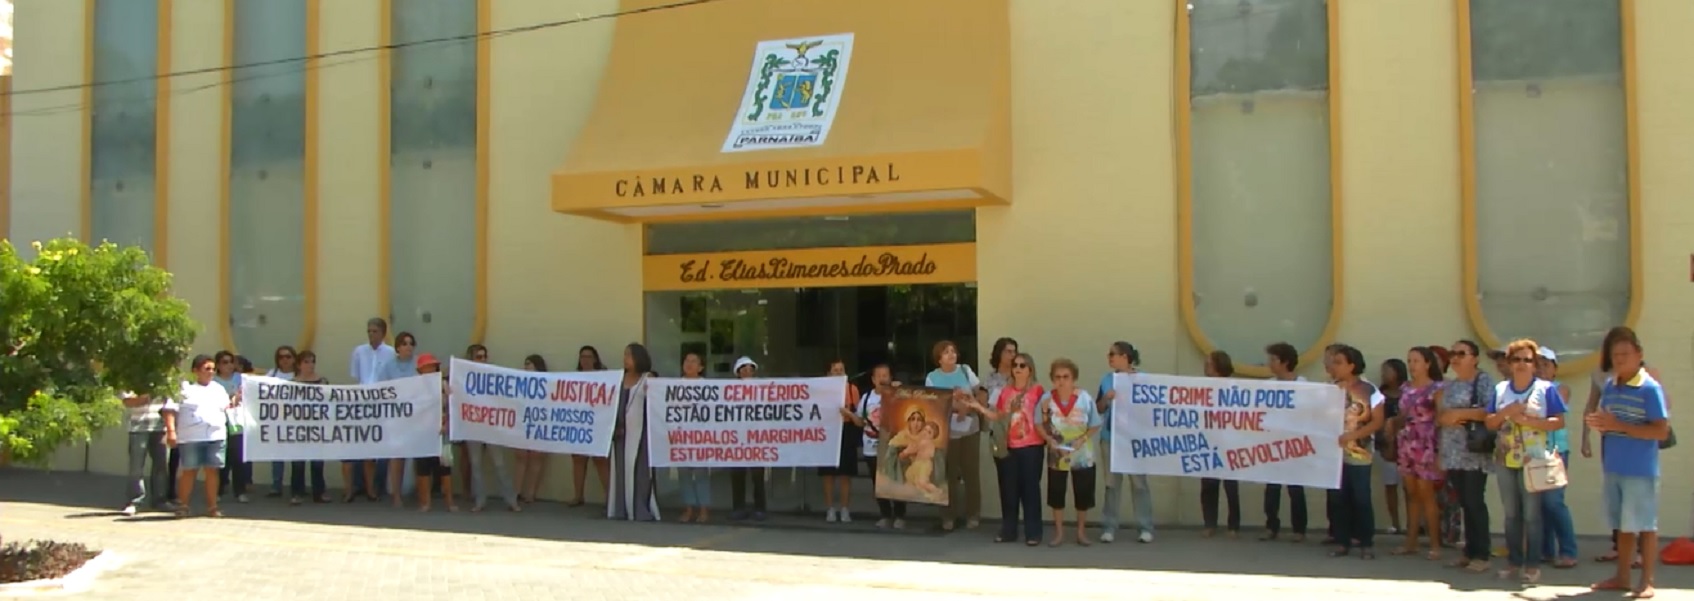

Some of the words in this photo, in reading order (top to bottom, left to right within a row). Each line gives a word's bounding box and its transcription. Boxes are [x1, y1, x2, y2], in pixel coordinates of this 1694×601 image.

[615, 174, 723, 197] CÂMARA
[745, 163, 900, 189] MUNICIPAL
[680, 259, 714, 282] Ed.
[719, 257, 767, 281] Elias
[767, 257, 849, 279] Ximenes
[850, 254, 875, 277] do
[873, 252, 937, 276] Prado
[258, 384, 324, 401] EXIGIMOS
[329, 387, 398, 402] ATITUDES
[465, 371, 548, 400] QUEREMOS
[551, 379, 616, 407] JUSTIÇA!
[665, 384, 720, 402] NOSSOS
[723, 381, 810, 401] CEMITÉRIOS
[1131, 384, 1168, 405] ESSE
[1169, 386, 1214, 407] CRIME
[1218, 385, 1250, 408] NÃO
[1254, 388, 1296, 409] PODE
[259, 402, 279, 421] DO
[283, 403, 330, 421] PODER
[335, 402, 413, 421] EXECUTIVO
[461, 403, 516, 428] RESPEITO
[522, 406, 548, 423] AOS
[551, 408, 595, 425] NOSSOS
[665, 402, 711, 423] ESTÃO
[714, 403, 803, 422] ENTREGUES
[809, 403, 822, 421] A
[1153, 408, 1199, 429] FICAR
[260, 425, 270, 442] E
[277, 425, 383, 443] LEGISLATIVO
[526, 422, 593, 444] FALECIDOS
[746, 427, 827, 444] MARGINAIS
[670, 446, 779, 462] ESTUPRADORES
[1181, 446, 1223, 473] ESTÁ
[1226, 435, 1316, 471] REVOLTADA
